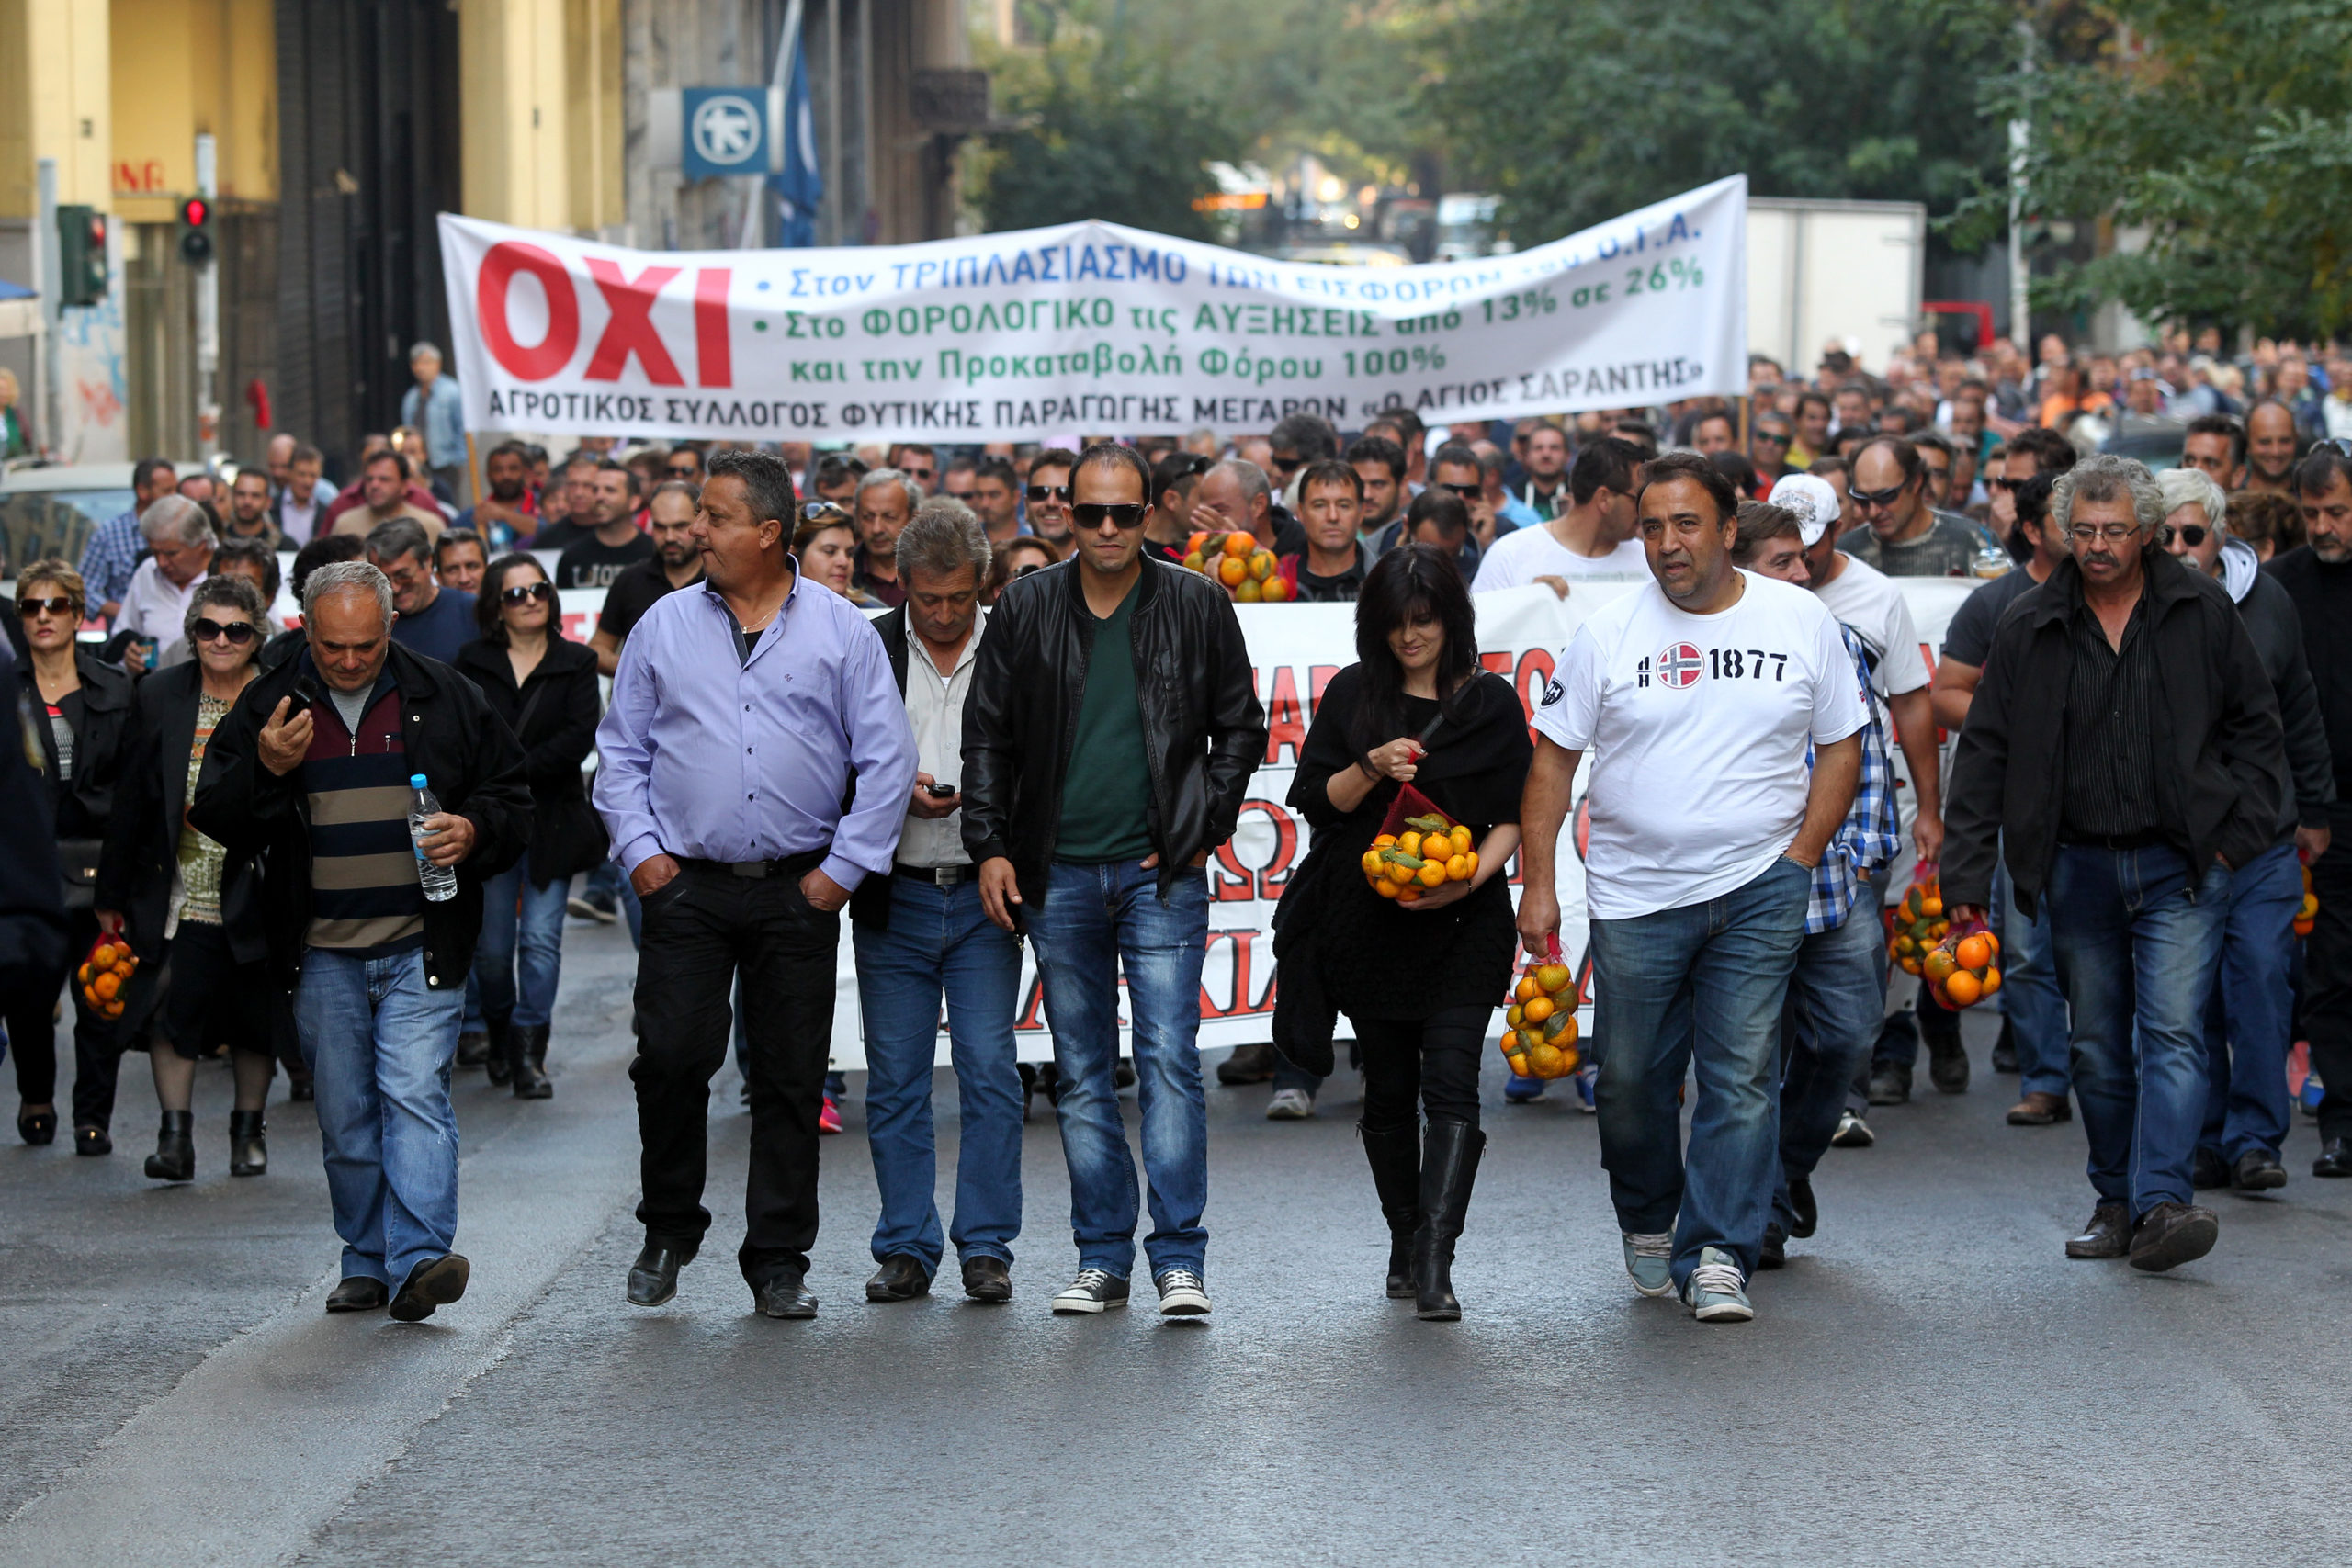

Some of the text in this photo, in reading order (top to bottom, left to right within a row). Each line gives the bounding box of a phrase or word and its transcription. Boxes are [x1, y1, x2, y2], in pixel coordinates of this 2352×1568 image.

[785, 256, 1705, 339] Στο ΦΟΡΟΛΟΓΙΚΟ τις ΑΥΞΗΣΕΙΣ από 13% σε 26%
[789, 268, 875, 297] Στον
[891, 244, 1187, 291] ΤΡΙΠΛΑΣΙΑΣΜΟ
[1295, 269, 1504, 302] ΕΙΣΦΟΡΩΝ
[477, 240, 733, 389] ΟΧΙ
[488, 389, 655, 423] ΑΓΡΟΤΙΚΟΣ
[666, 399, 829, 428] ΣΥΛΛΟΓΟΣ
[841, 400, 982, 428] ΦΥΤΙΚΗΣ
[994, 395, 1181, 429] ΠΑΡΑΓΩΓΗΣ
[1193, 395, 1347, 423] ΜΕΓΑΡΩΝ
[1413, 377, 1509, 411] ΑΓΙΟΣ
[1518, 357, 1704, 402] ΣΑΡΑΝΤΗΣ»
[790, 342, 1447, 387] και την Προκαταβολή Φόρου 100%
[1709, 648, 1788, 682] 1877
